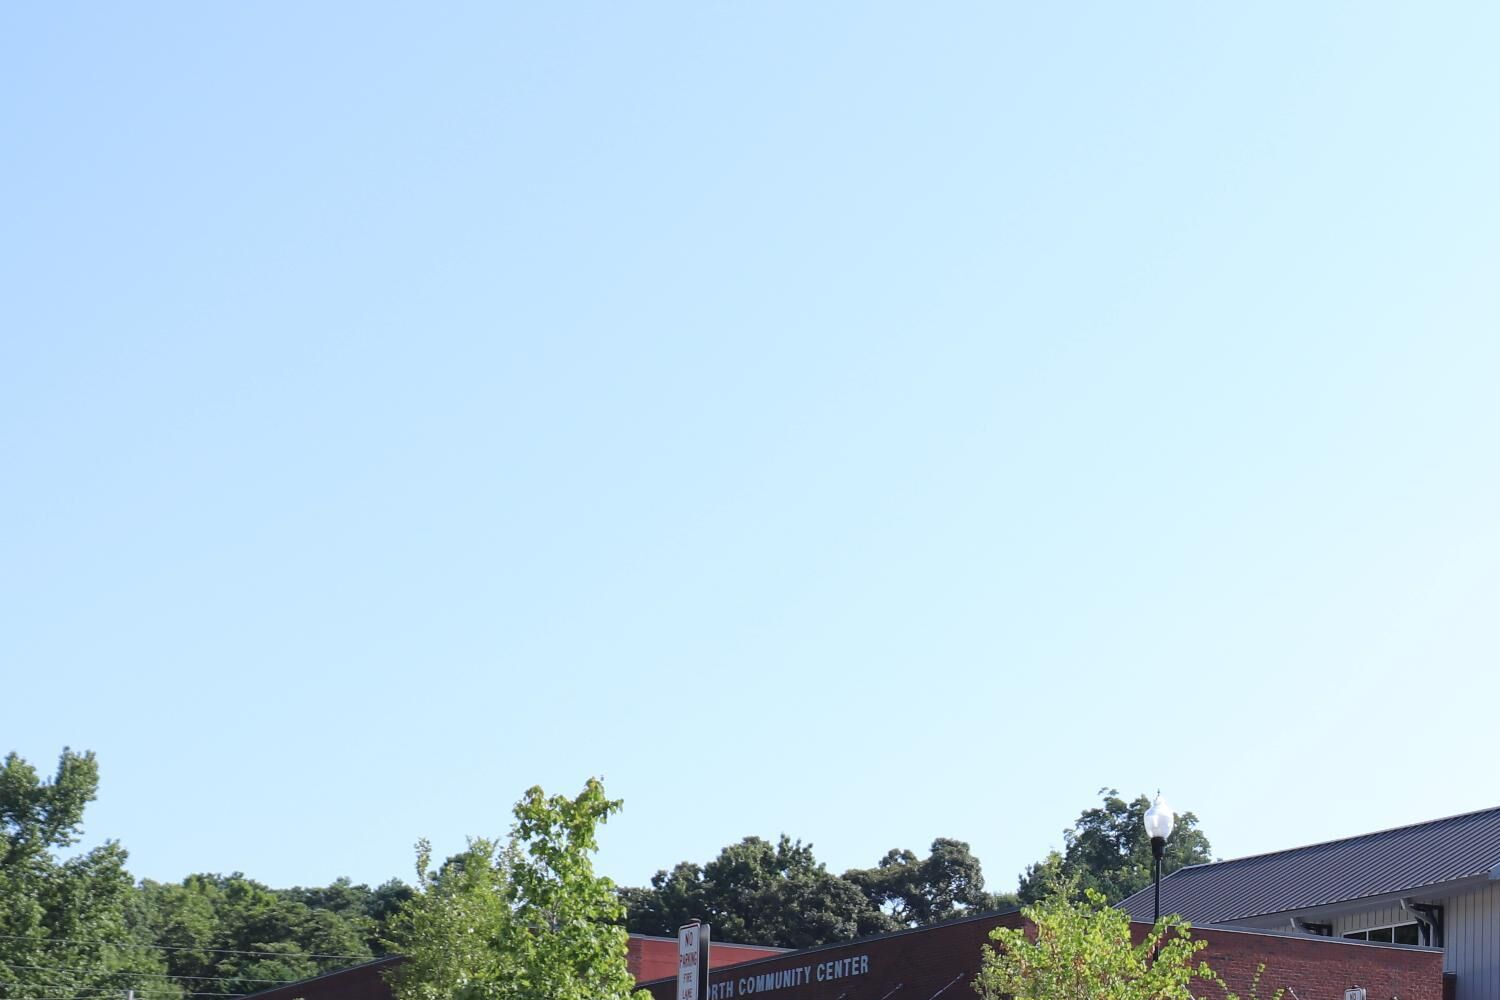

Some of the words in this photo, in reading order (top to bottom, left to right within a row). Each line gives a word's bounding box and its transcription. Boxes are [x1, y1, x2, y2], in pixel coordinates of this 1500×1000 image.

[684, 930, 694, 947] NO
[679, 952, 697, 968] PARKING
[738, 966, 811, 996] COMMUNITY
[816, 954, 869, 982] CENTER
